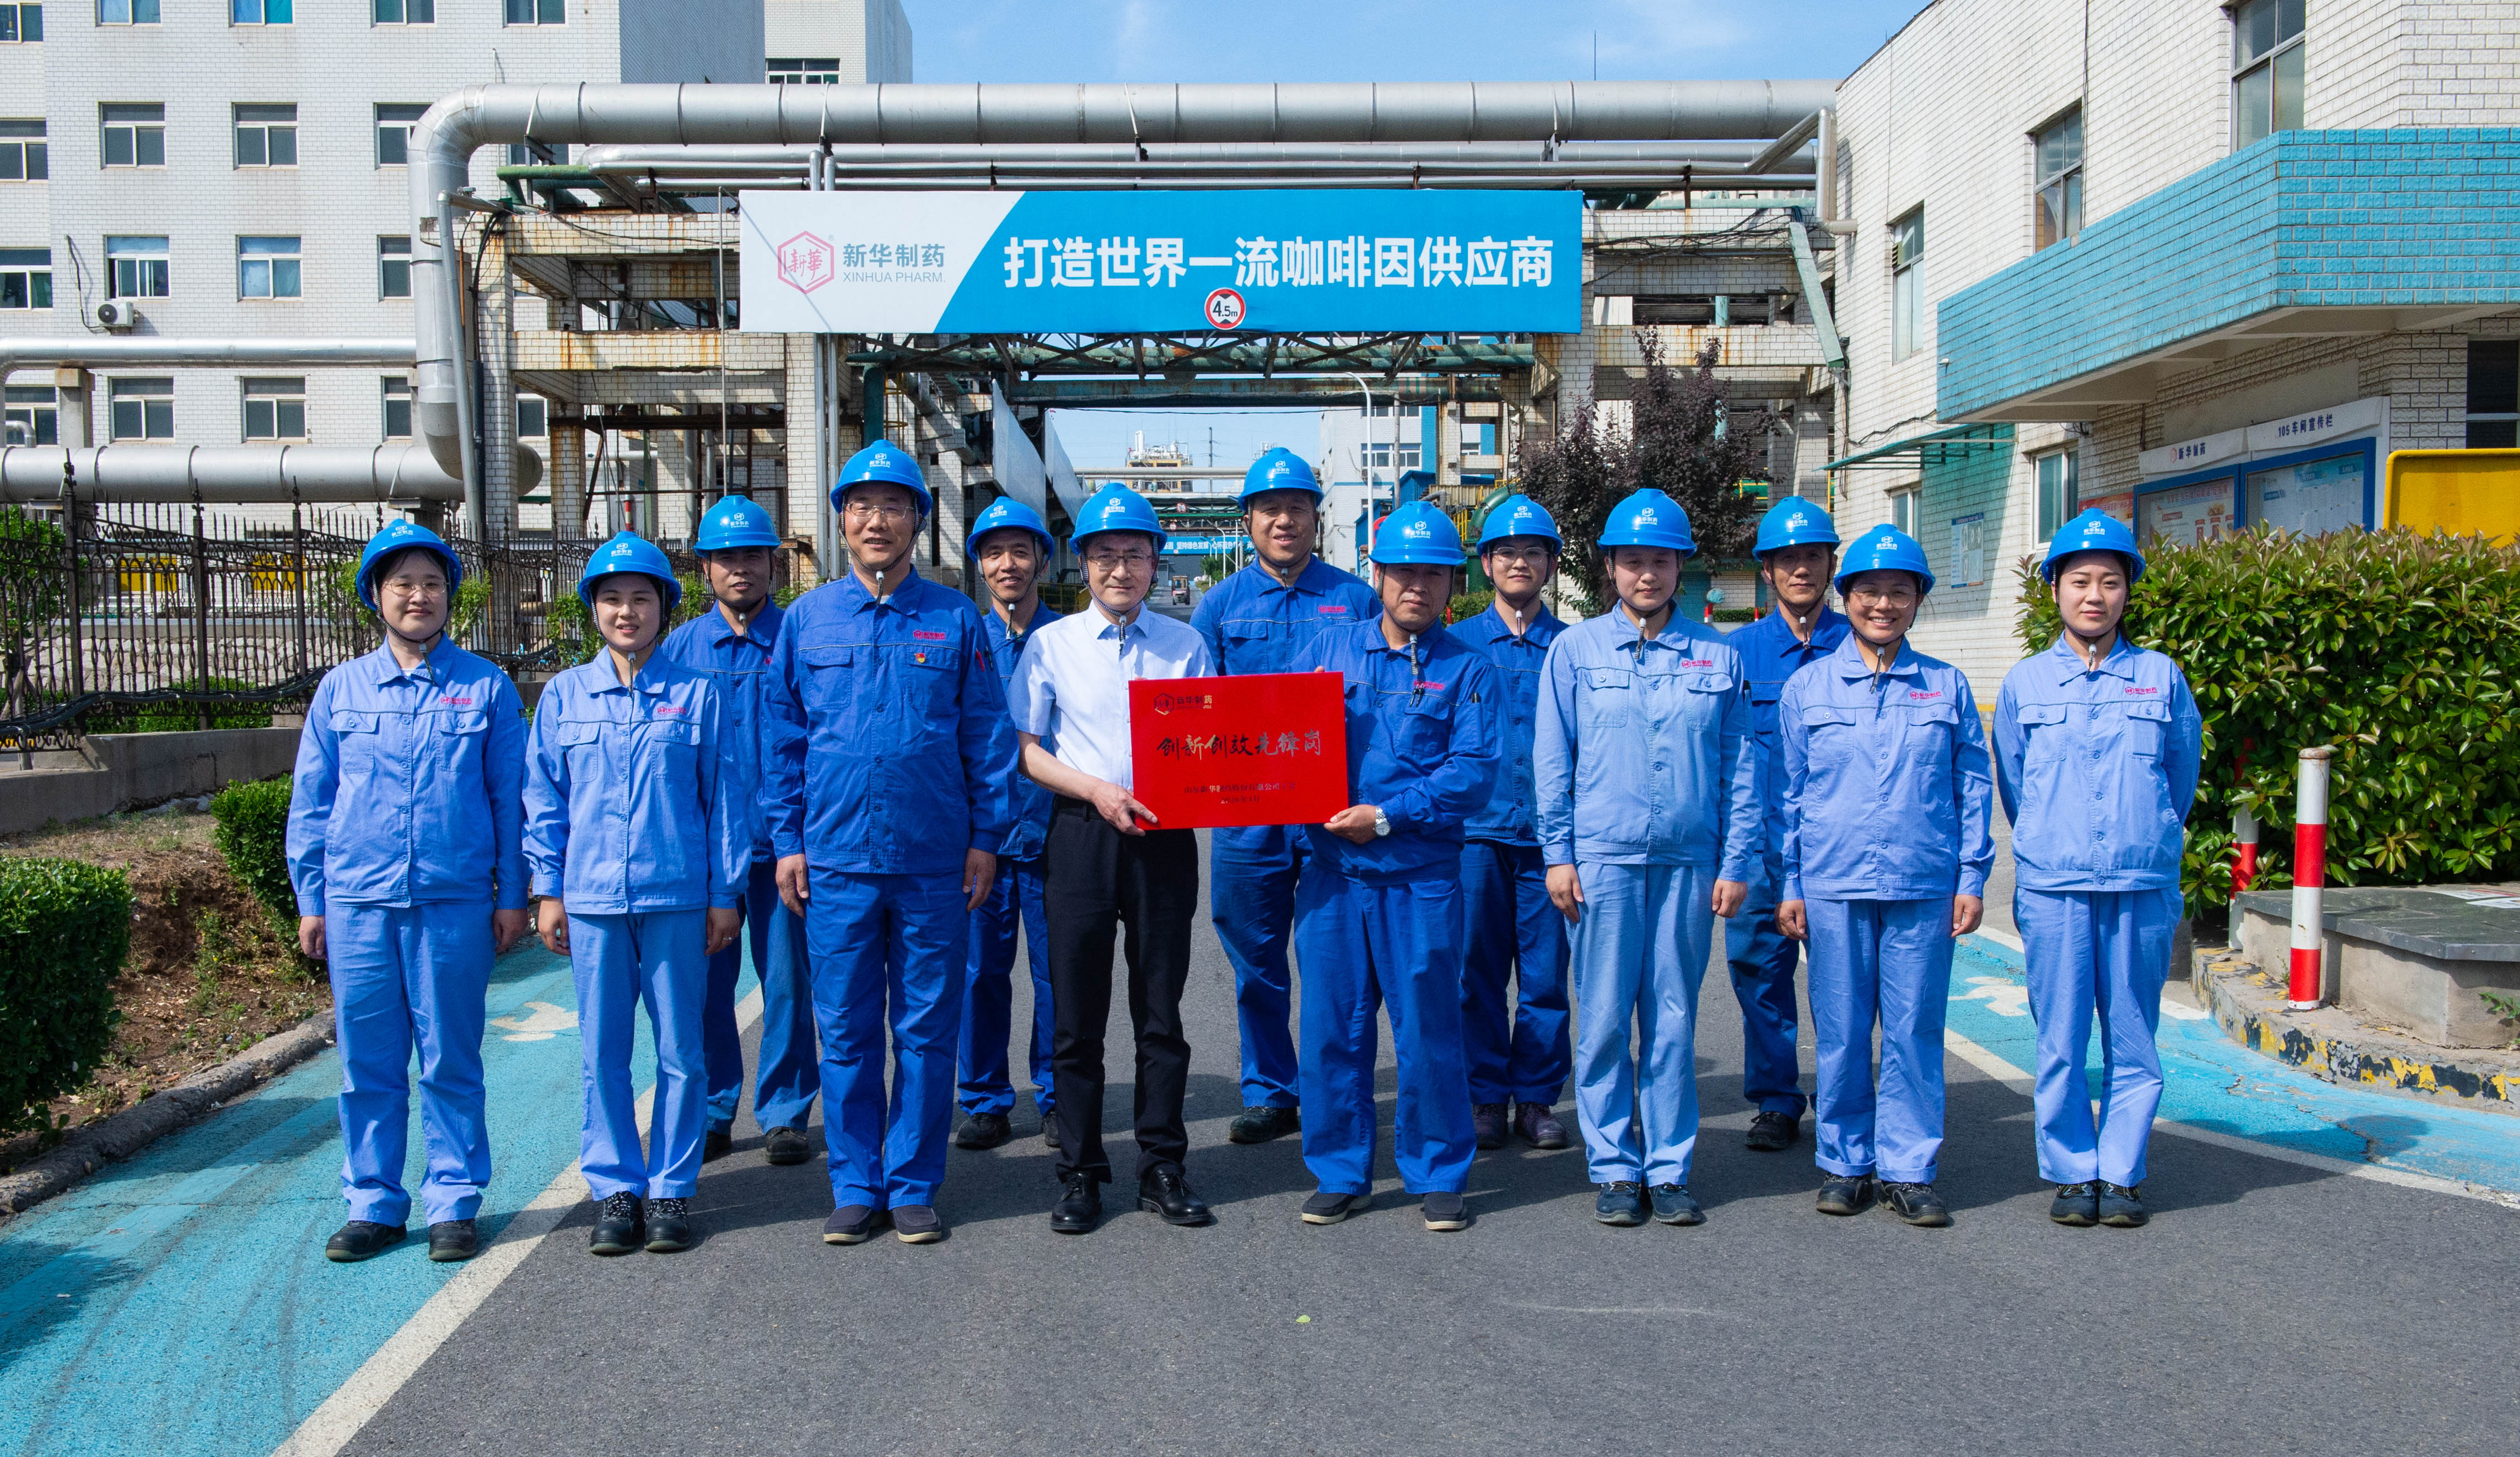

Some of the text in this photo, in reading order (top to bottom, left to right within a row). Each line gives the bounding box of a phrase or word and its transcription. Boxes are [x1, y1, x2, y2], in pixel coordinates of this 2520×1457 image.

[843, 244, 945, 268] 新华制药
[1004, 236, 1553, 288] 打造世界一流咖啡因供应商
[843, 272, 946, 283] XINHUA PHARM.
[1212, 300, 1238, 317] 4.5m
[1157, 729, 1321, 760] 创新创效先锋岗
